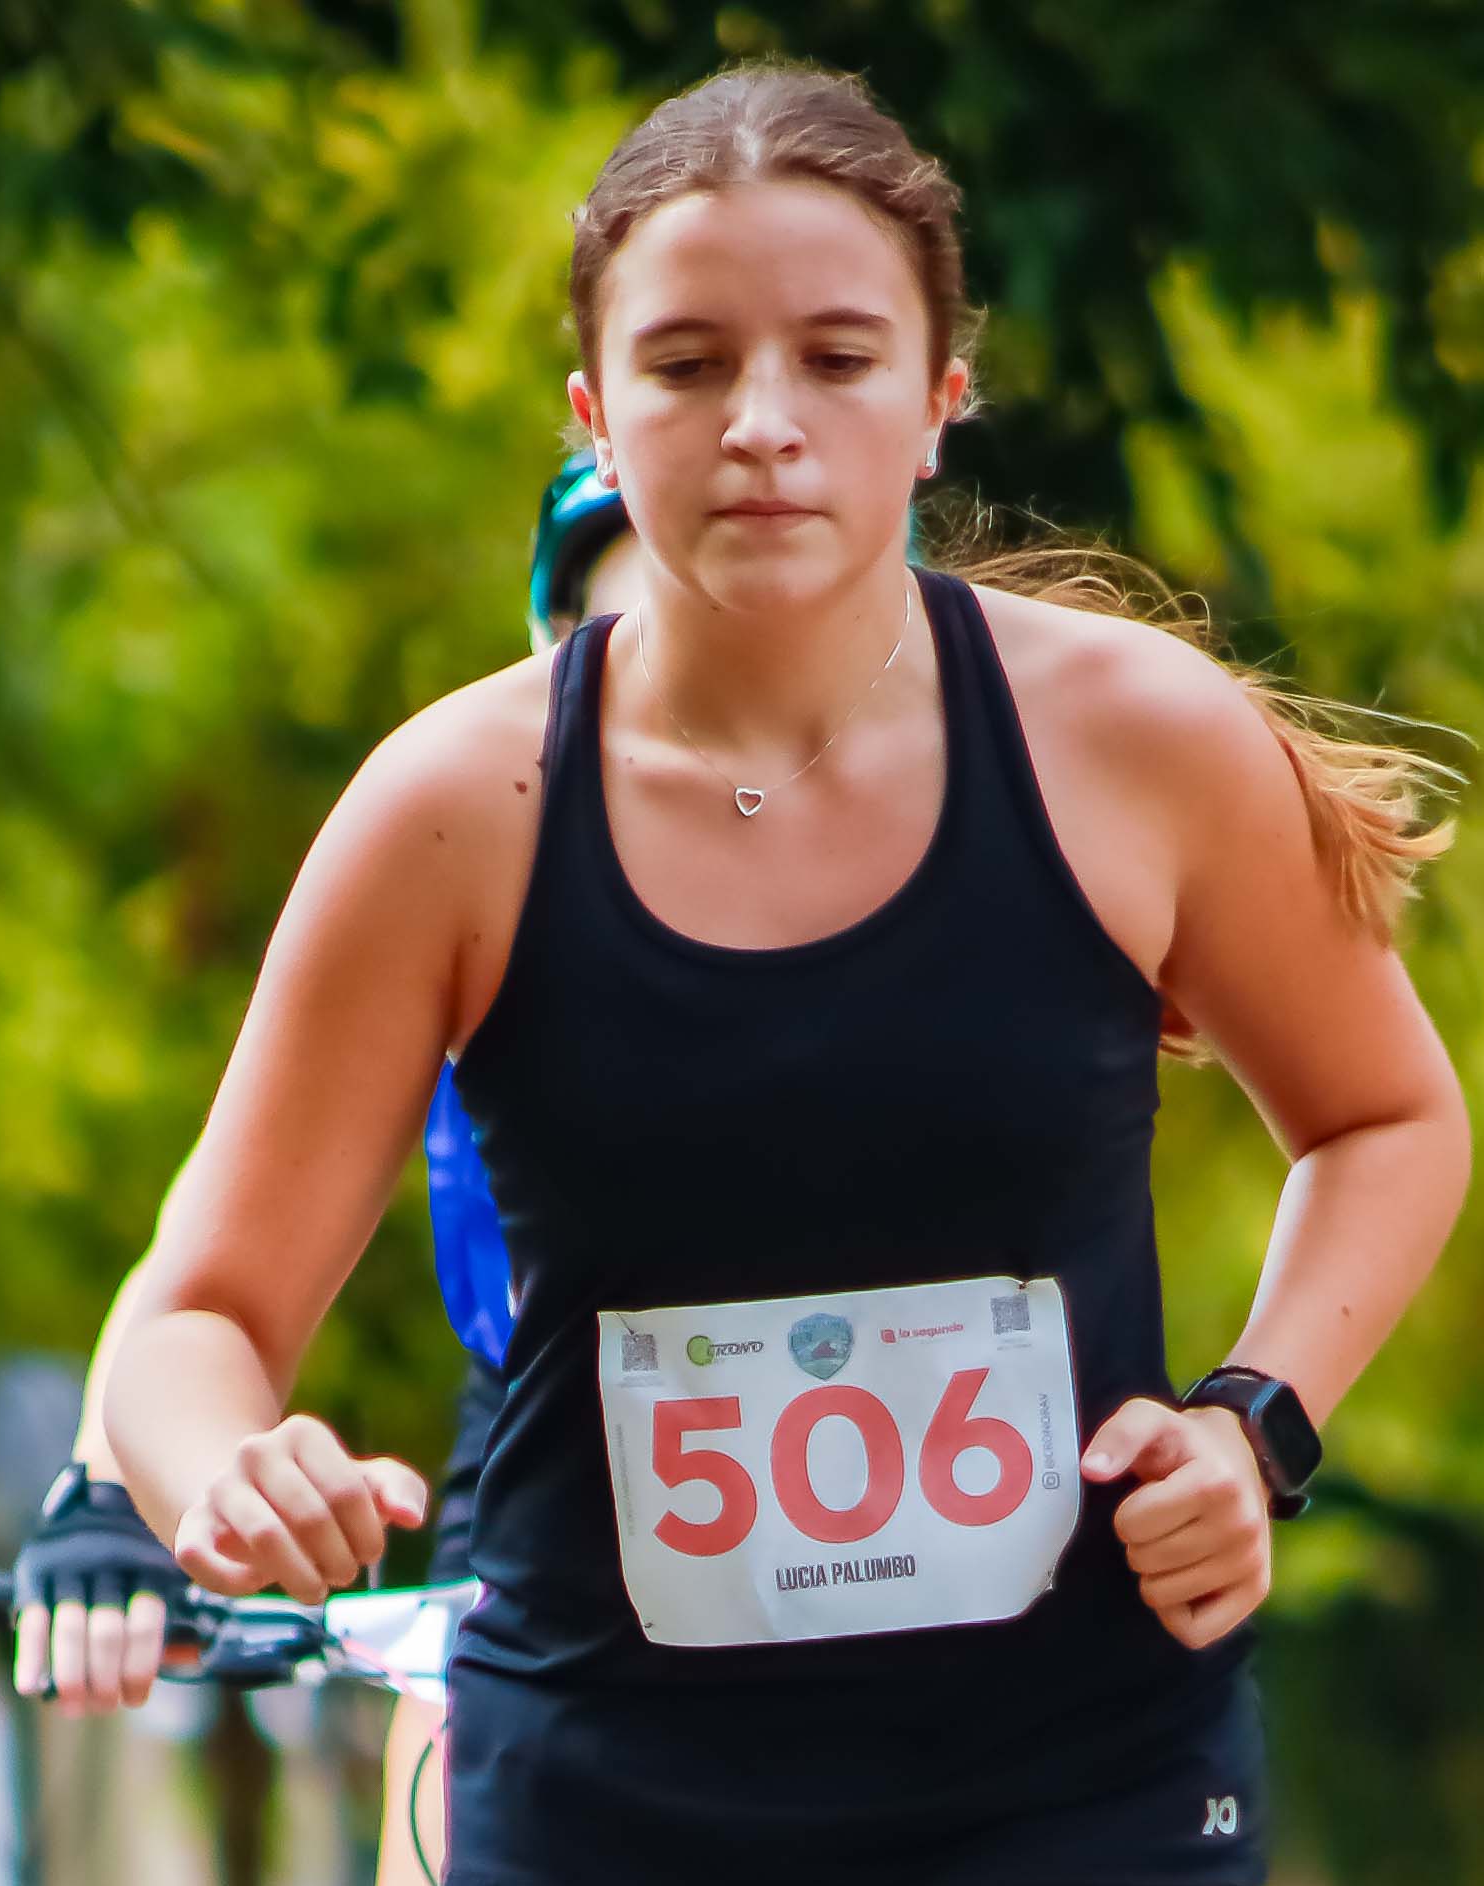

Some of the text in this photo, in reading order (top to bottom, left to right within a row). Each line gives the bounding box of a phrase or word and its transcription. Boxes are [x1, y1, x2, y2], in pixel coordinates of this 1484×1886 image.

[652, 1367, 1033, 1557] 506
[776, 1554, 916, 1591] LUCIA PALUMBO
